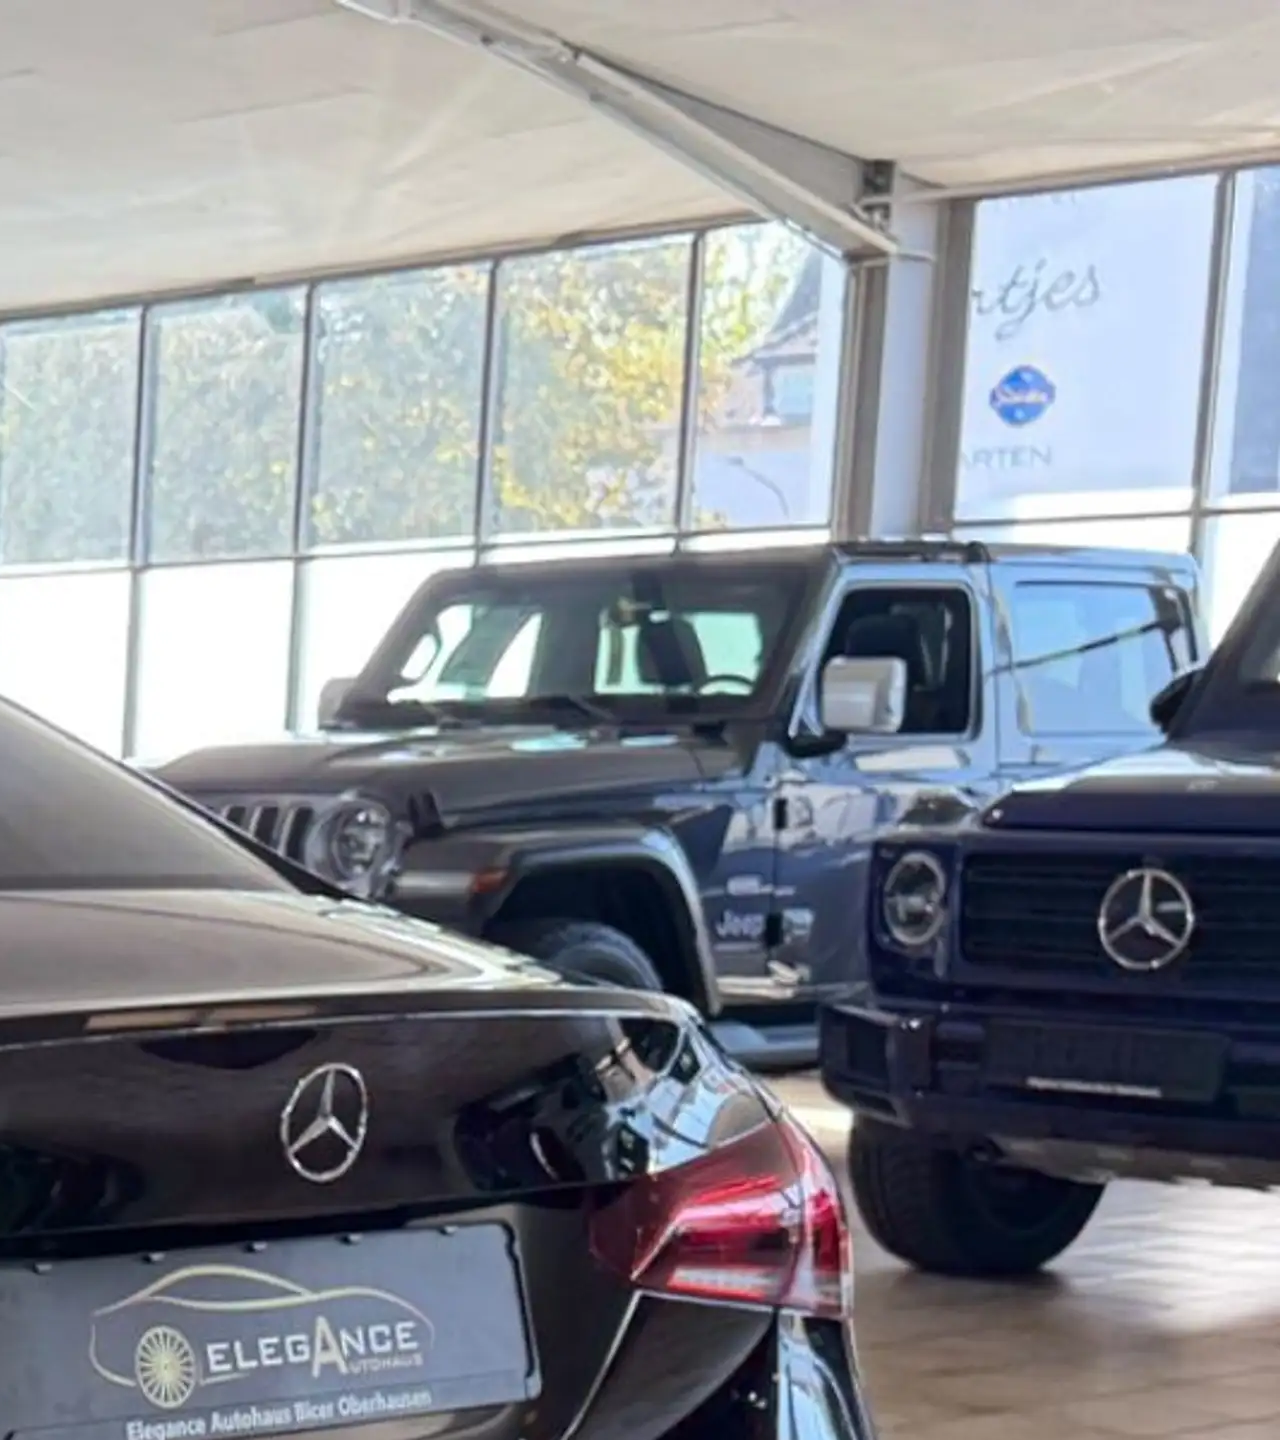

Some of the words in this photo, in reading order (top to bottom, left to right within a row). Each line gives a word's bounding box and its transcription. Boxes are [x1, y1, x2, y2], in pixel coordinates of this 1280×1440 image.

[207, 1316, 418, 1378] ELEGANCE
[211, 1404, 291, 1432] Autohaus
[338, 1390, 432, 1416] Oberhausen
